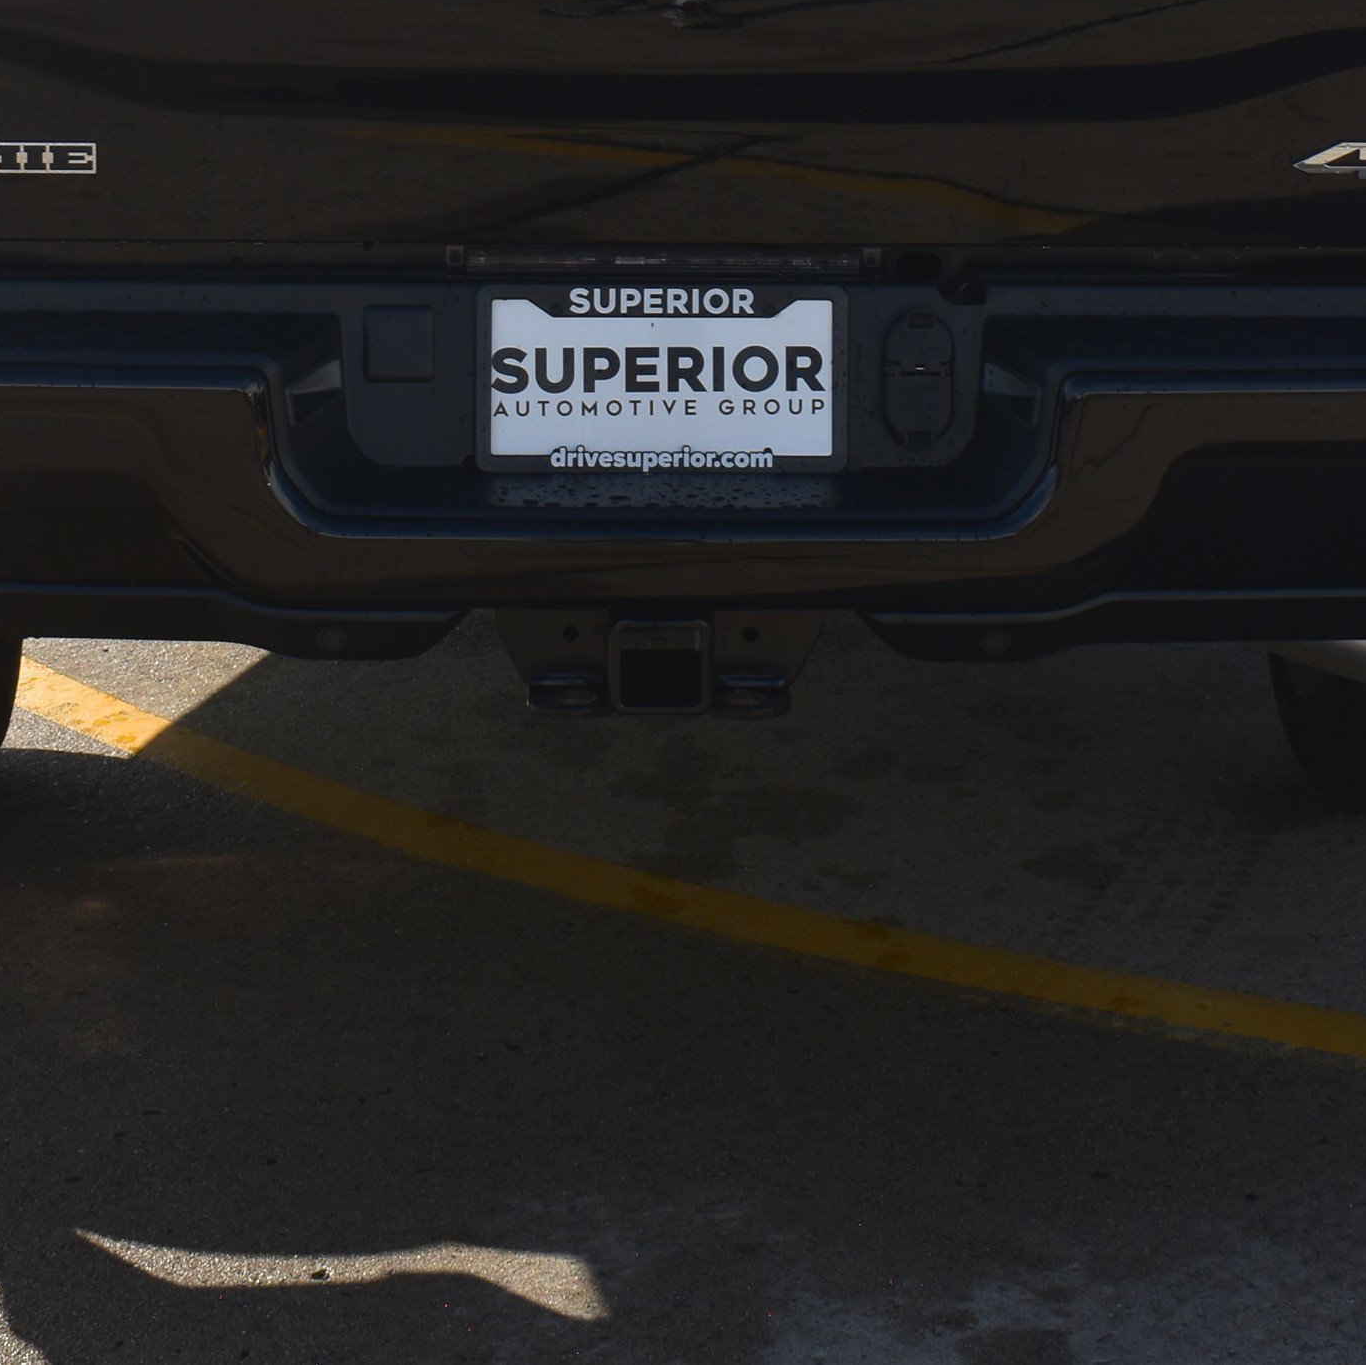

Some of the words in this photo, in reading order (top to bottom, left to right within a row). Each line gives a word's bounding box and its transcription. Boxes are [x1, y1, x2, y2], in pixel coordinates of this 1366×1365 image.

[569, 287, 755, 315] SUPERIOR
[491, 345, 826, 394] SUPERIOR
[493, 399, 697, 417] AUTOMOTIVE
[718, 398, 825, 415] GROUP
[550, 445, 774, 472] drivesuperior.com
